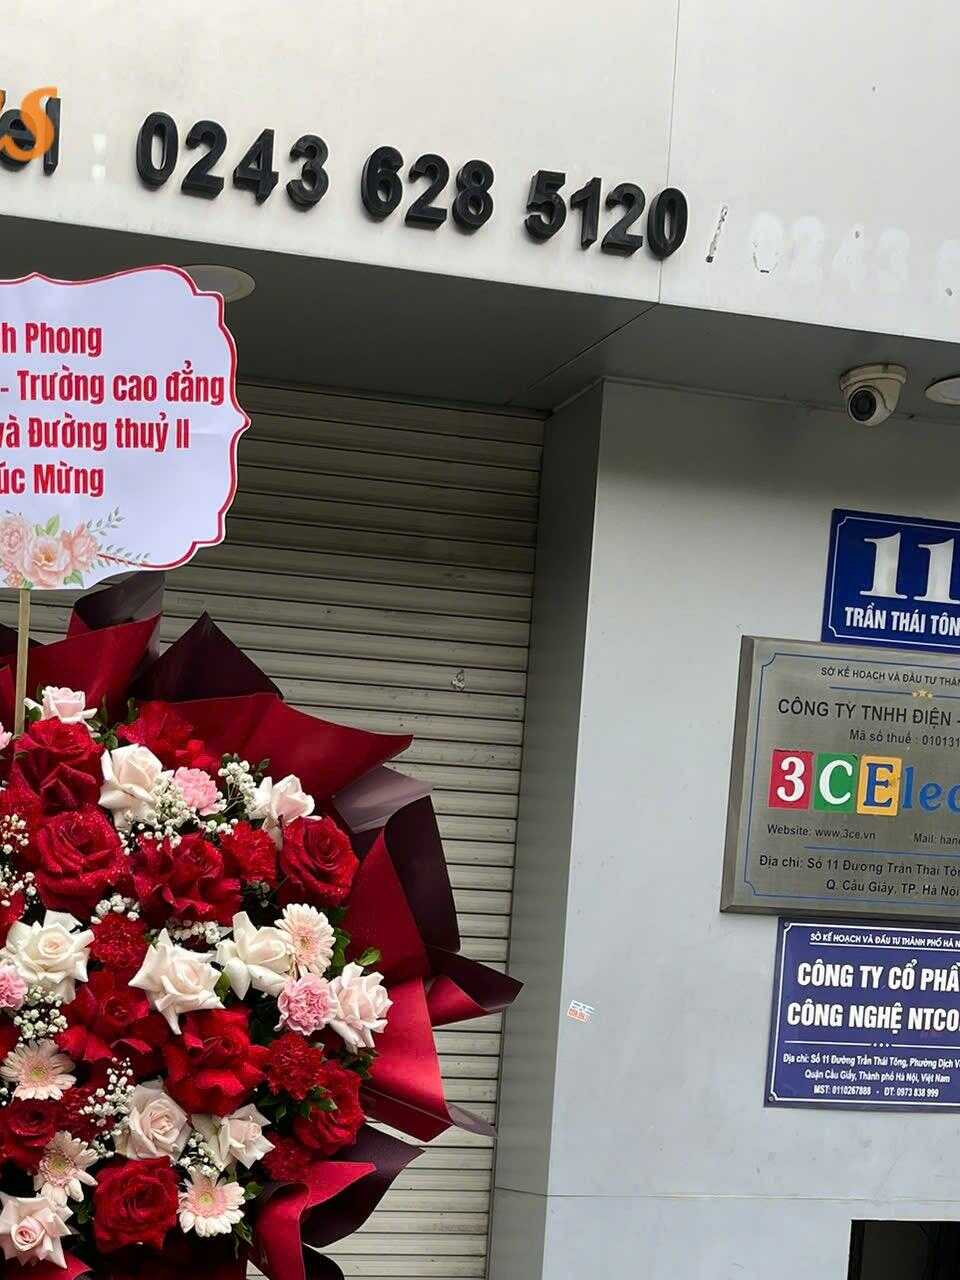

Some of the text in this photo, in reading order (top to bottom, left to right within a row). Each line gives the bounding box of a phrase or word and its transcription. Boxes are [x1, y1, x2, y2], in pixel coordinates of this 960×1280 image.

[136, 111, 330, 208] 0243
[361, 145, 495, 234] 628
[524, 169, 688, 260] 5120
[25, 322, 102, 357] Phong
[17, 364, 105, 404] Trường
[113, 374, 157, 401] cao
[165, 360, 225, 406] đẳng
[28, 412, 107, 451] Đường
[115, 411, 169, 452] thuỷ
[176, 418, 189, 448] II
[34, 460, 104, 497] Mừng
[860, 531, 960, 605] 11
[844, 602, 887, 630] TRẦN
[890, 609, 927, 633] THÁI
[778, 696, 829, 717] CÔNG
[835, 702, 856, 720] TY
[861, 704, 907, 723] TNHH
[912, 706, 952, 730] ĐIỆN
[849, 729, 866, 742] Mã
[827, 859, 839, 871] 11
[797, 958, 854, 988] CÔNG
[860, 965, 883, 989] TY
[888, 958, 917, 991] CỔ
[787, 998, 843, 1028] CÔNG
[848, 1002, 903, 1035] NGHỆ
